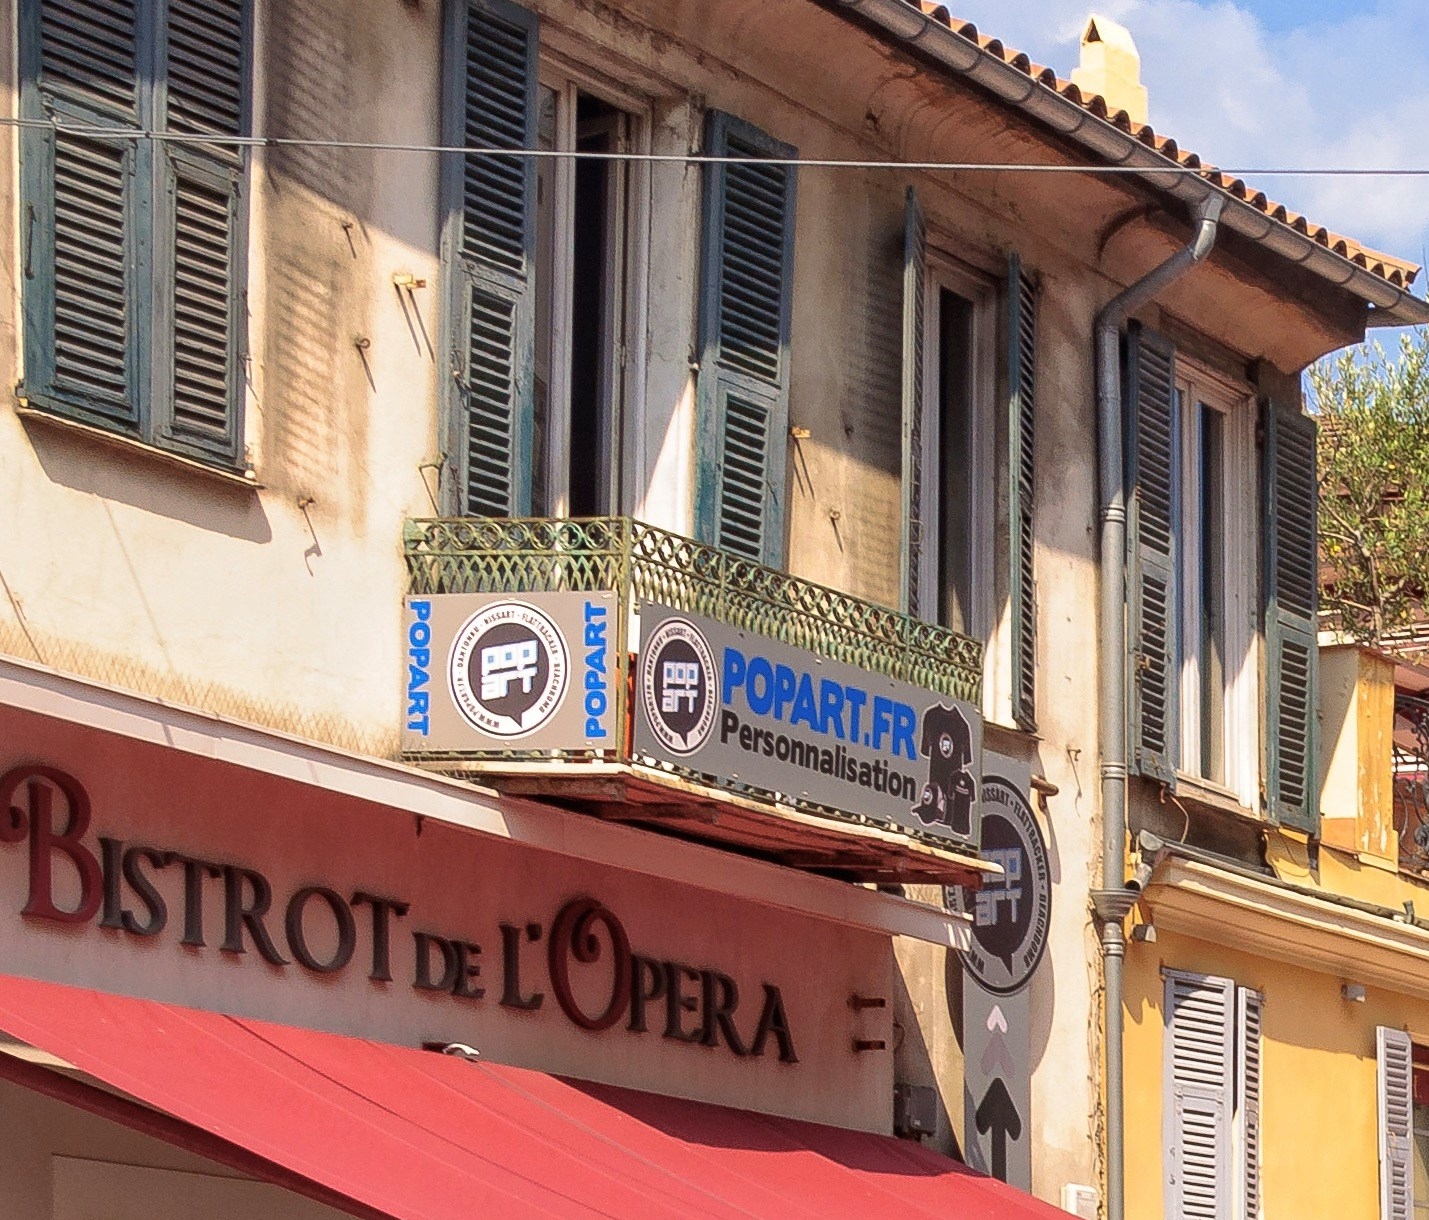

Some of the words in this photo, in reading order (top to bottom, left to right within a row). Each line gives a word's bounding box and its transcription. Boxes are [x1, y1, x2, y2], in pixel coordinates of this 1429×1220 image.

[407, 600, 431, 736] POPART
[585, 602, 607, 737] POPART
[723, 647, 917, 761] POPART.FR
[720, 709, 916, 801] Personnalisation
[0, 764, 409, 982] BISTROT
[412, 930, 485, 999] DE
[499, 897, 800, 1064] L'OPERA
